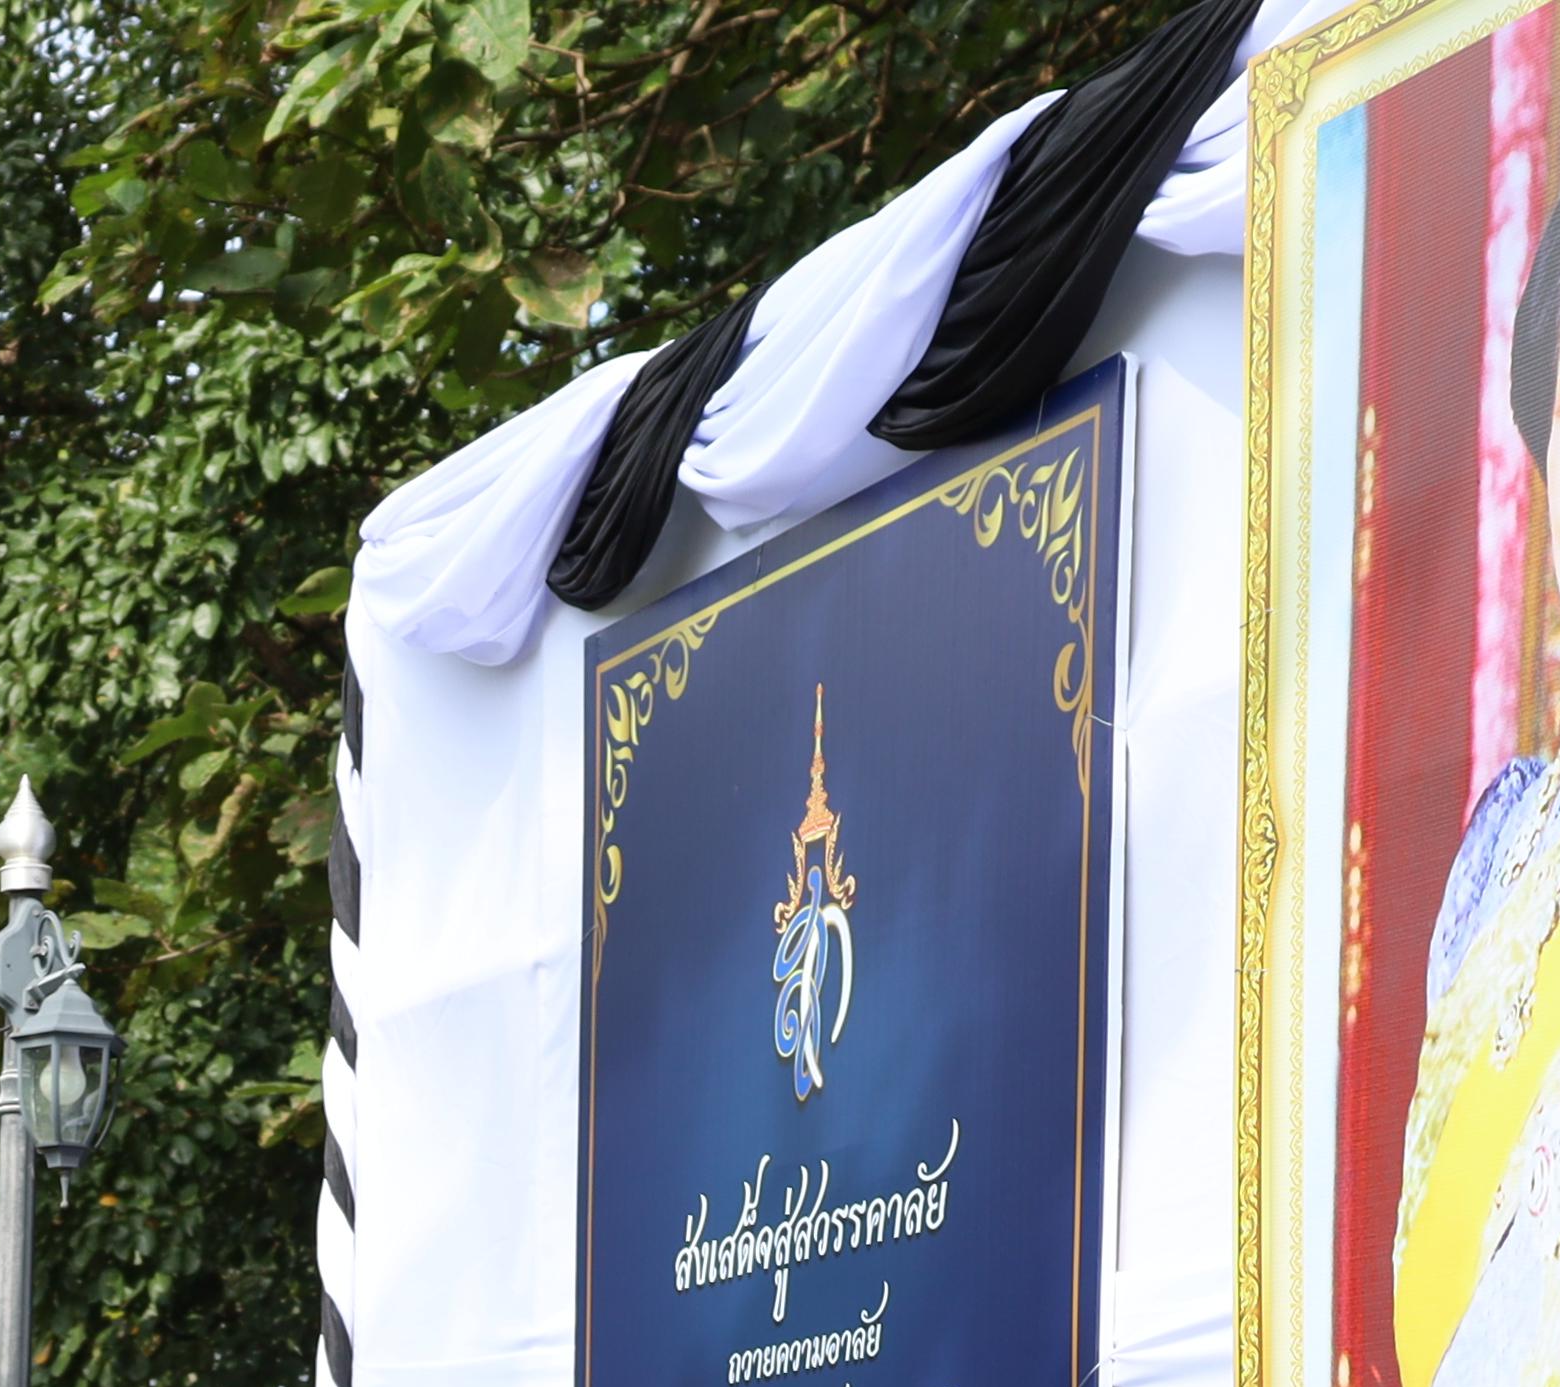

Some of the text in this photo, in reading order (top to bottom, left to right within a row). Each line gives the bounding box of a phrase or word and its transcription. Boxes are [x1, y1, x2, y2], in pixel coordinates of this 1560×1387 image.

[674, 1118, 959, 1323] ส่งเสด็จสู่สวรรคาลัย
[728, 1281, 889, 1384] ถวายความอาลัย
